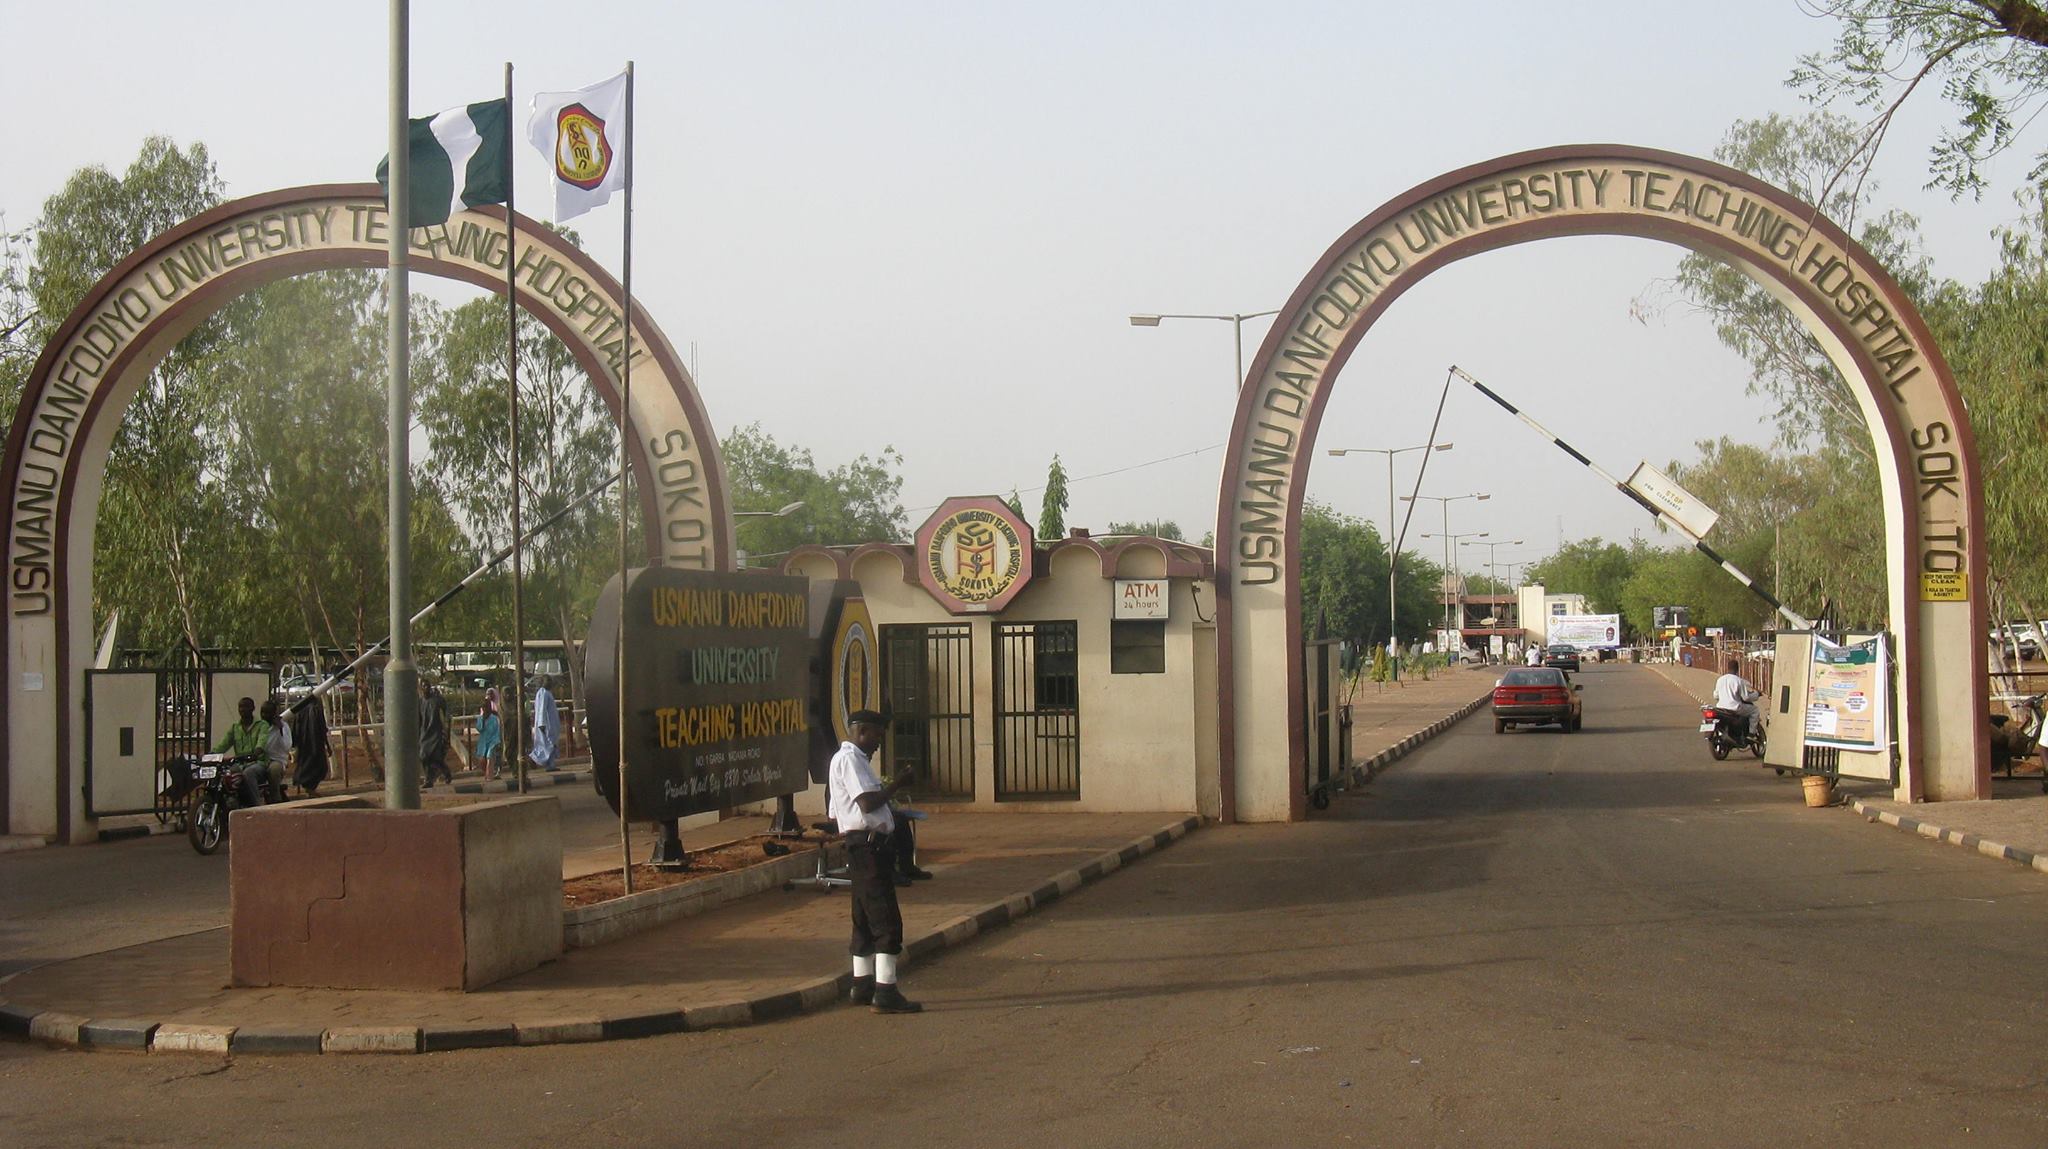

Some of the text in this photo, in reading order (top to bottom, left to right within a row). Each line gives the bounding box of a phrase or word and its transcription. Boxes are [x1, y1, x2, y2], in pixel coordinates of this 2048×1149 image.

[1395, 169, 1608, 253] UNIVERSITY
[1622, 170, 1804, 260] TEACHING
[1264, 237, 1401, 418] DANFODIYO
[1798, 242, 1921, 403] HOSPITAL
[13, 205, 706, 616] USMANU DANFODIYO UNIVERSITY TECHING HOSPITAL SOKOT
[1240, 421, 1294, 586] USMANU
[1666, 490, 1683, 504] STOP
[959, 576, 994, 590] SOKOTO
[1124, 583, 1159, 598] ATM
[1136, 600, 1159, 608] hours
[652, 587, 806, 629] USMANU DANFODIYO
[692, 646, 780, 685] UNIVERSITY
[655, 698, 809, 749] TEACHING HOSPITAL
[690, 776, 707, 796] Mail
